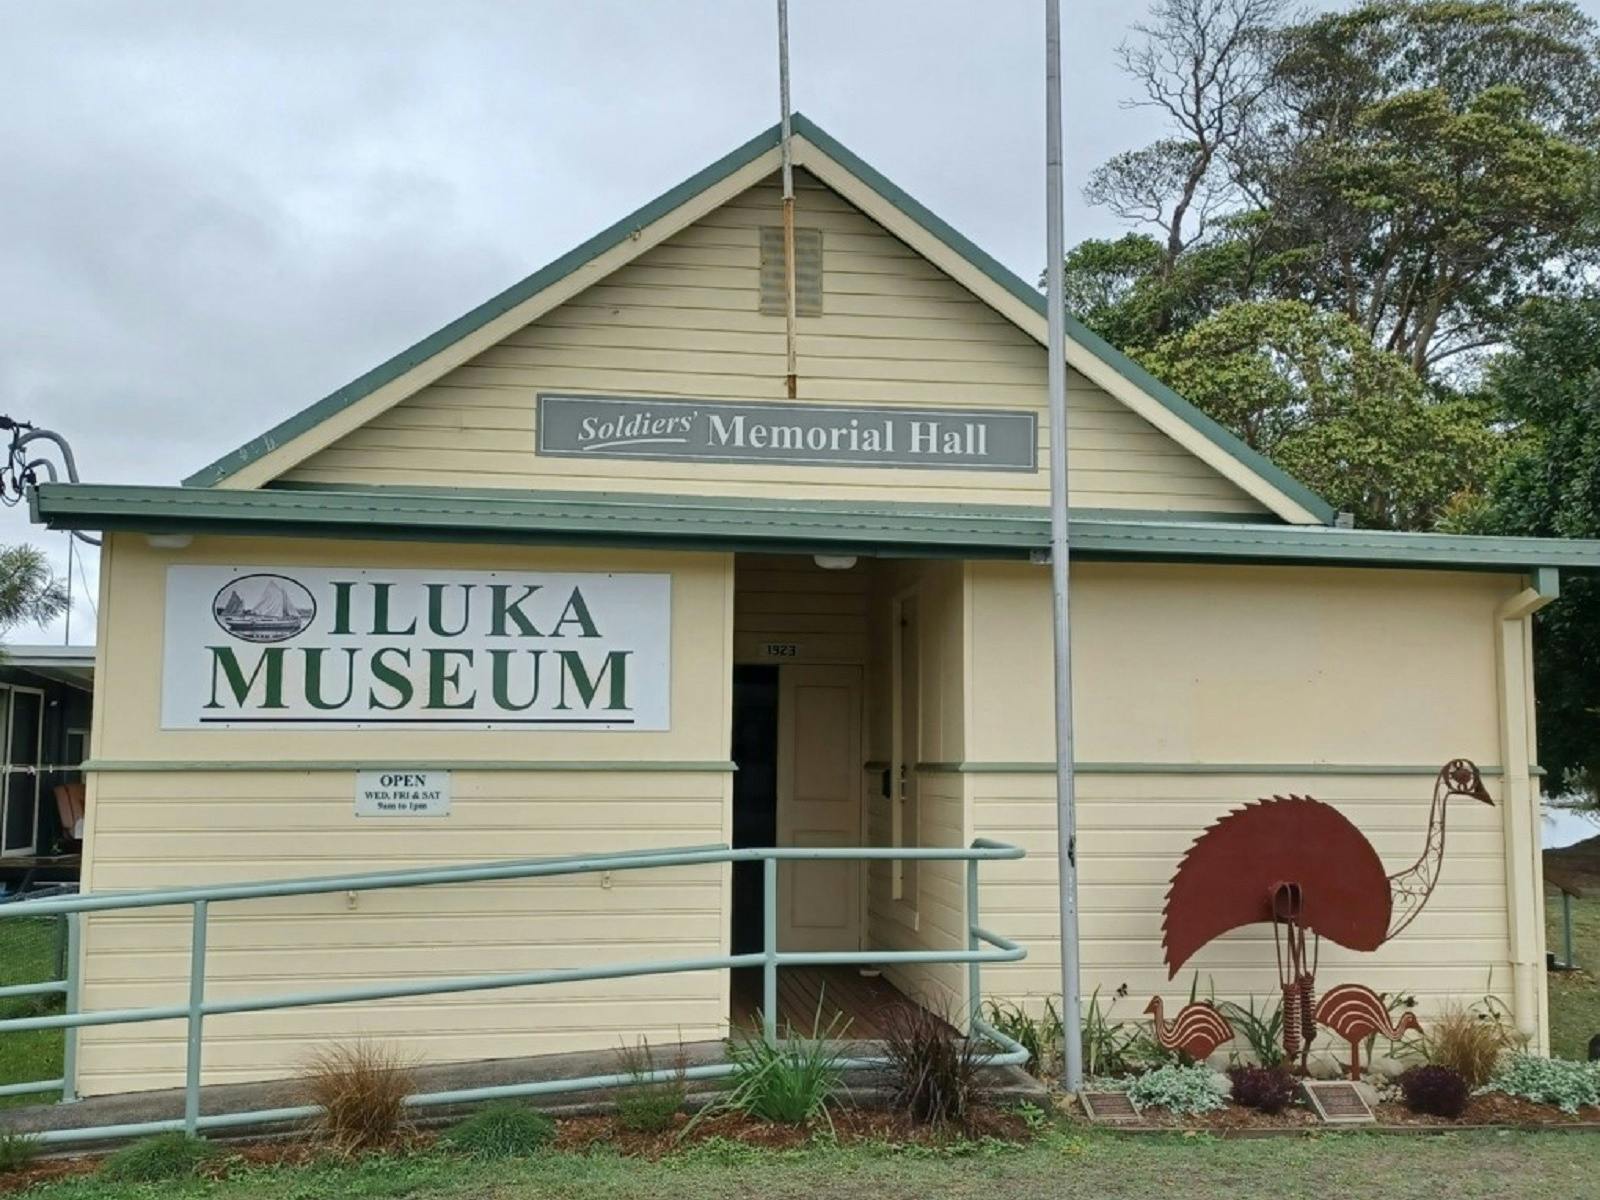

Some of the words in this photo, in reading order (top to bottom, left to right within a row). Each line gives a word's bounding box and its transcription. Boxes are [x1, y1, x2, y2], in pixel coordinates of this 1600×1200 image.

[578, 411, 699, 442] Soldiers'
[707, 414, 895, 453] Memorial
[908, 421, 989, 457] Hall
[327, 581, 603, 638] ILUKA
[767, 644, 796, 657] 1923
[203, 646, 634, 711] MUSEUM
[380, 774, 426, 787] OPEN
[393, 791, 410, 800] FRI
[412, 791, 419, 800] &
[422, 791, 441, 800] SAT
[377, 802, 396, 810] 9am
[398, 802, 407, 810] to
[409, 802, 428, 811] 1pm
